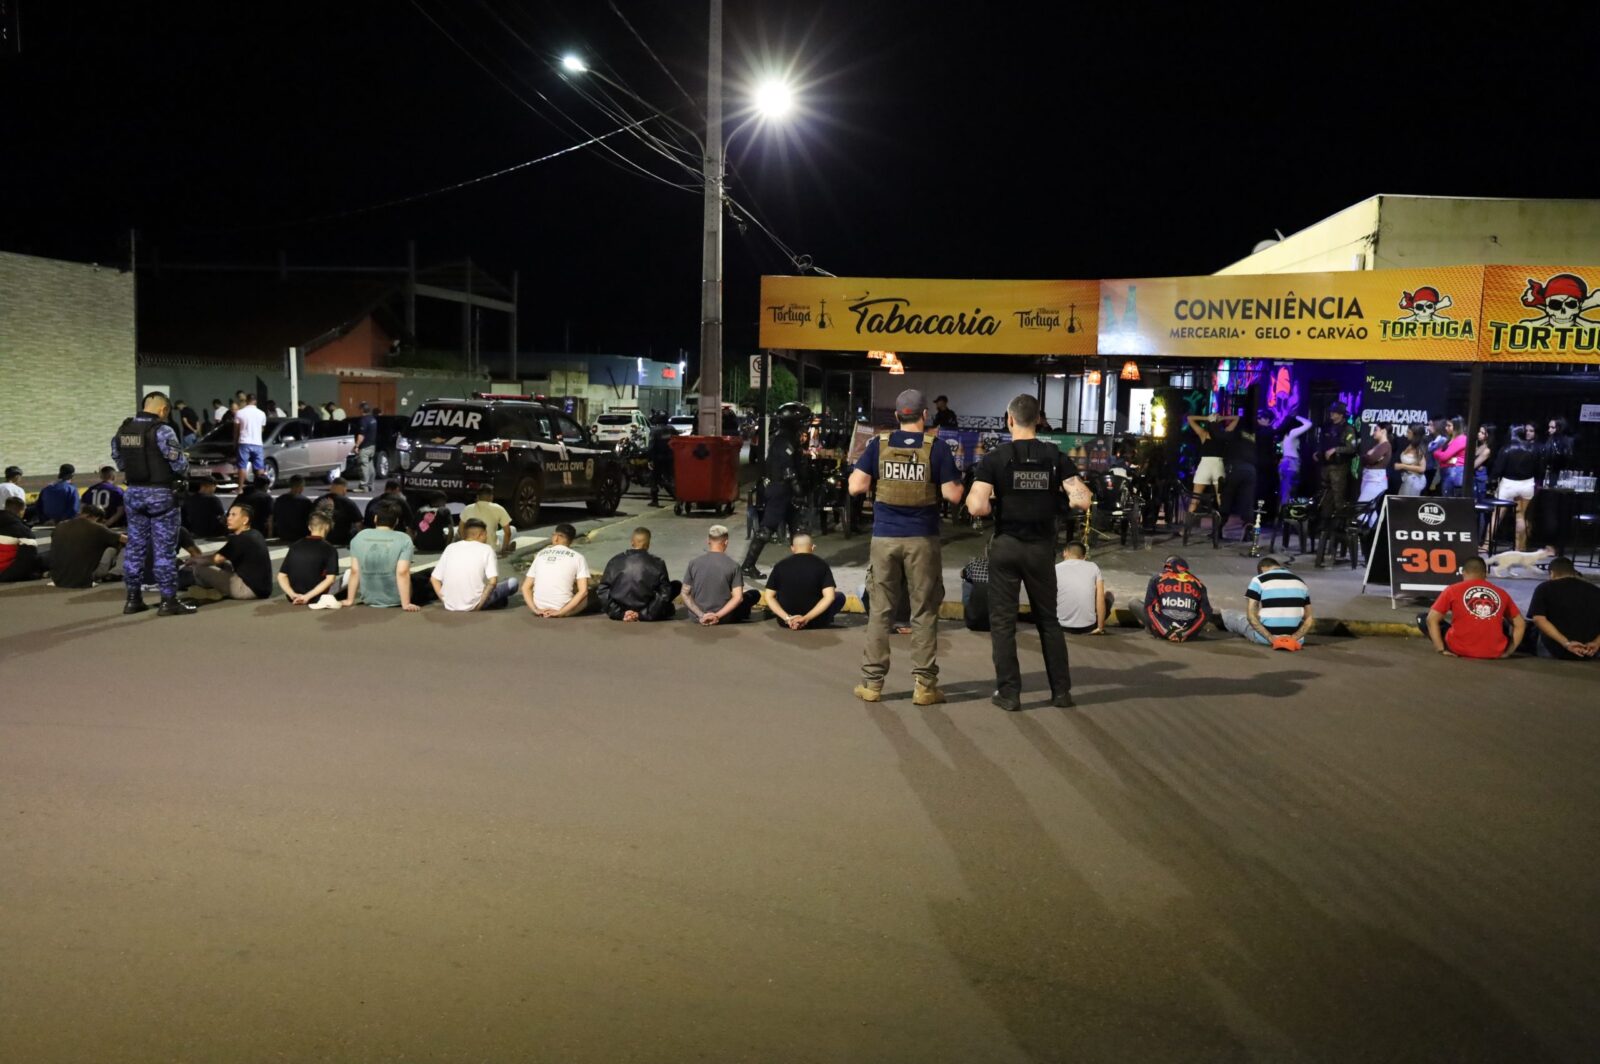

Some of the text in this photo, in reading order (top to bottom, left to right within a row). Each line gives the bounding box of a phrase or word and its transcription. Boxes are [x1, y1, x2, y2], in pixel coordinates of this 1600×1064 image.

[1174, 291, 1364, 320] CONVENIÊNCIA
[848, 298, 1001, 335] Tabacaria
[1169, 323, 1368, 339] MERCEARIA GELO CARVÃO
[1379, 319, 1474, 339] TORTUGA
[1370, 380, 1393, 393] 424
[410, 409, 482, 430] DENAR
[1361, 409, 1429, 424] @TABACARIA
[570, 462, 585, 471] CIVIL
[885, 462, 924, 480] DENAR
[91, 489, 110, 508] 10
[1395, 530, 1472, 542] CORTE
[1157, 582, 1182, 596] Red
